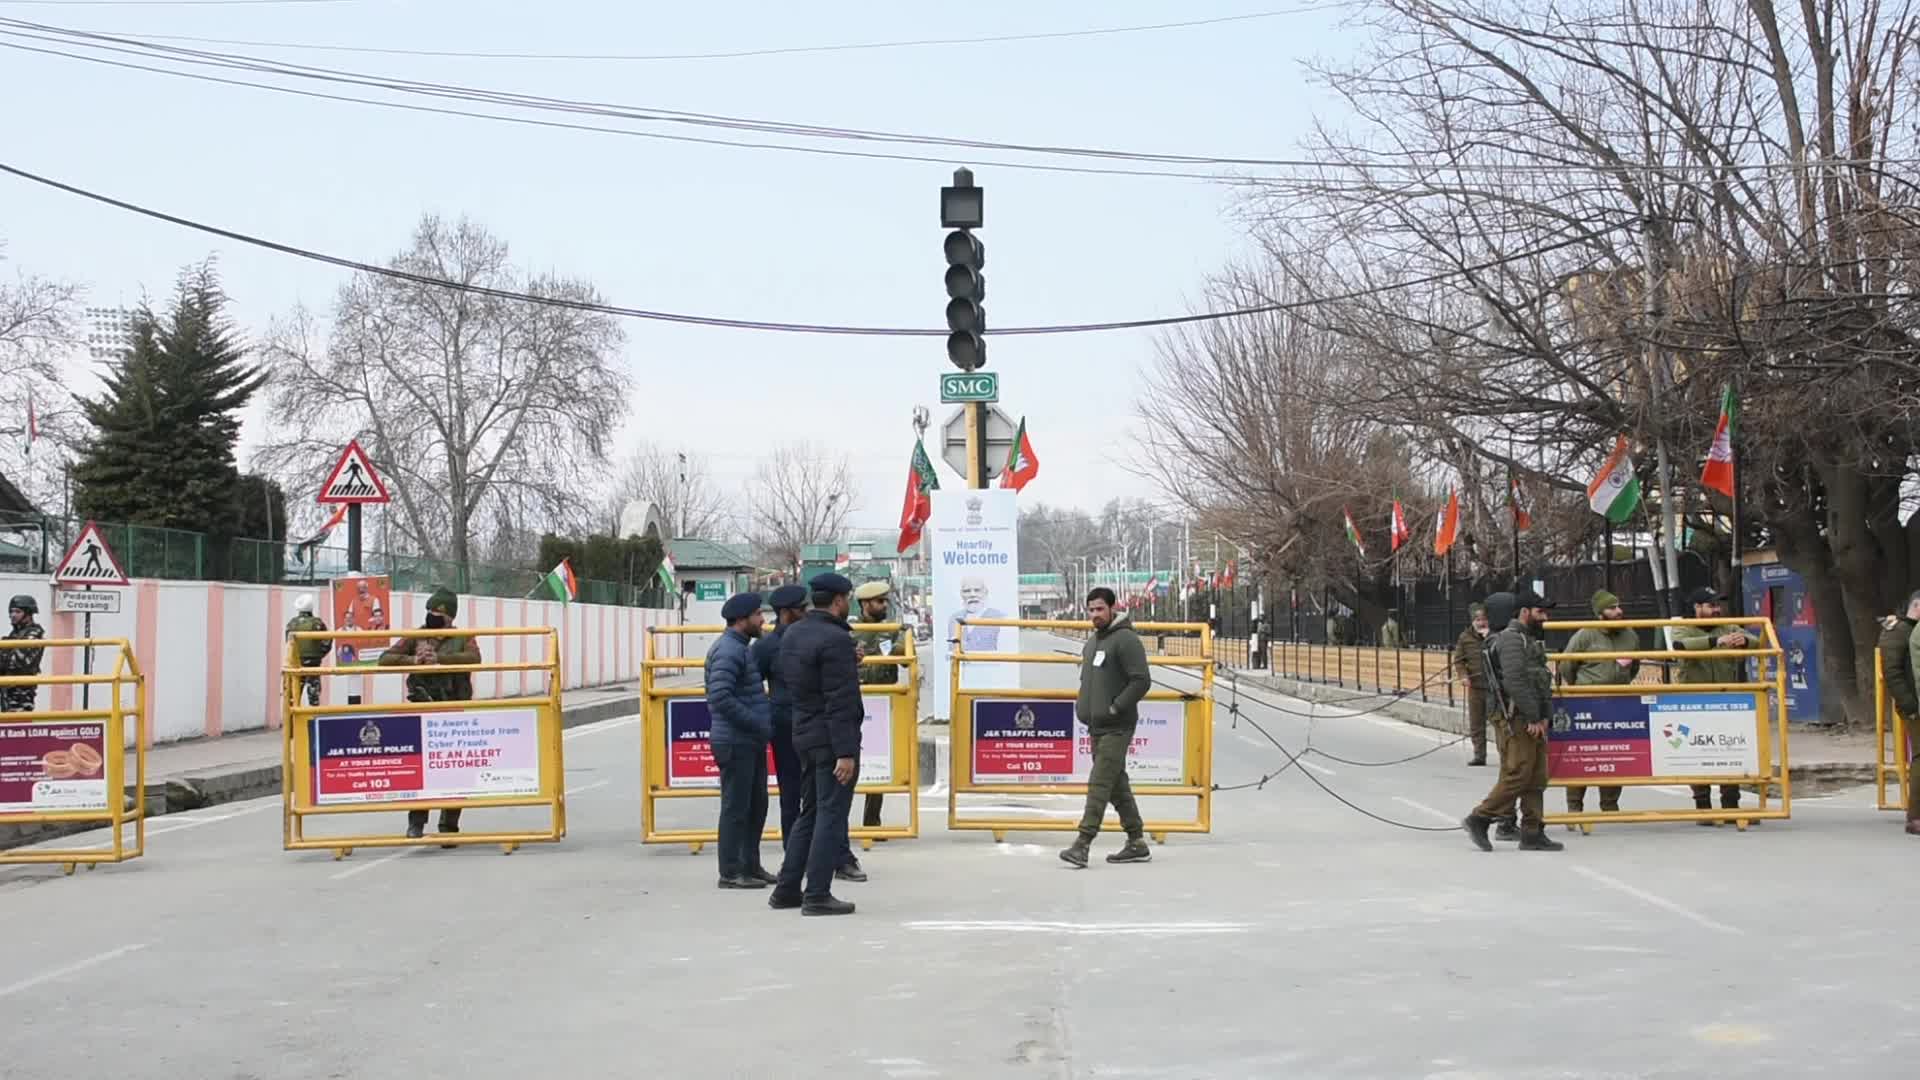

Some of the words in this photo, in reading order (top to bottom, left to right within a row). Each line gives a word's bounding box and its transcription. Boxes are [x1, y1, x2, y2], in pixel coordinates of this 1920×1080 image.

[946, 379, 990, 394] SMC
[943, 551, 1008, 565] Welcome
[63, 592, 114, 600] Pedestrian
[67, 601, 109, 611] Crossing
[1656, 703, 1678, 711] YOUR
[1680, 703, 1702, 711] BANK
[1574, 712, 1592, 720] J&K
[442, 719, 469, 727] Aware
[1146, 717, 1167, 725] from
[1574, 722, 1612, 730] TRAFFIC
[1615, 721, 1645, 729] POLICE
[7, 729, 26, 738] Bank
[28, 728, 49, 737] LOAN
[50, 728, 78, 738] against
[80, 727, 101, 736] GOLD
[428, 730, 448, 738] Stay
[451, 728, 495, 736] Protected
[499, 727, 520, 735] from
[680, 731, 697, 739] J&K
[428, 740, 454, 749] Cyber
[457, 739, 488, 747] Frauds
[1689, 734, 1716, 746] J&K
[1719, 733, 1747, 746] Bank
[328, 748, 344, 756] J&K
[346, 747, 382, 755] TRAFFIC
[384, 745, 415, 753] POLICE
[429, 751, 445, 760] BE
[447, 750, 463, 759] AN
[466, 748, 502, 758] ALERT
[372, 758, 403, 766] SERVICE
[429, 758, 492, 769] CUSTOMER.
[1022, 762, 1042, 770] 103
[1598, 764, 1616, 772] 103
[370, 779, 391, 788] 103
